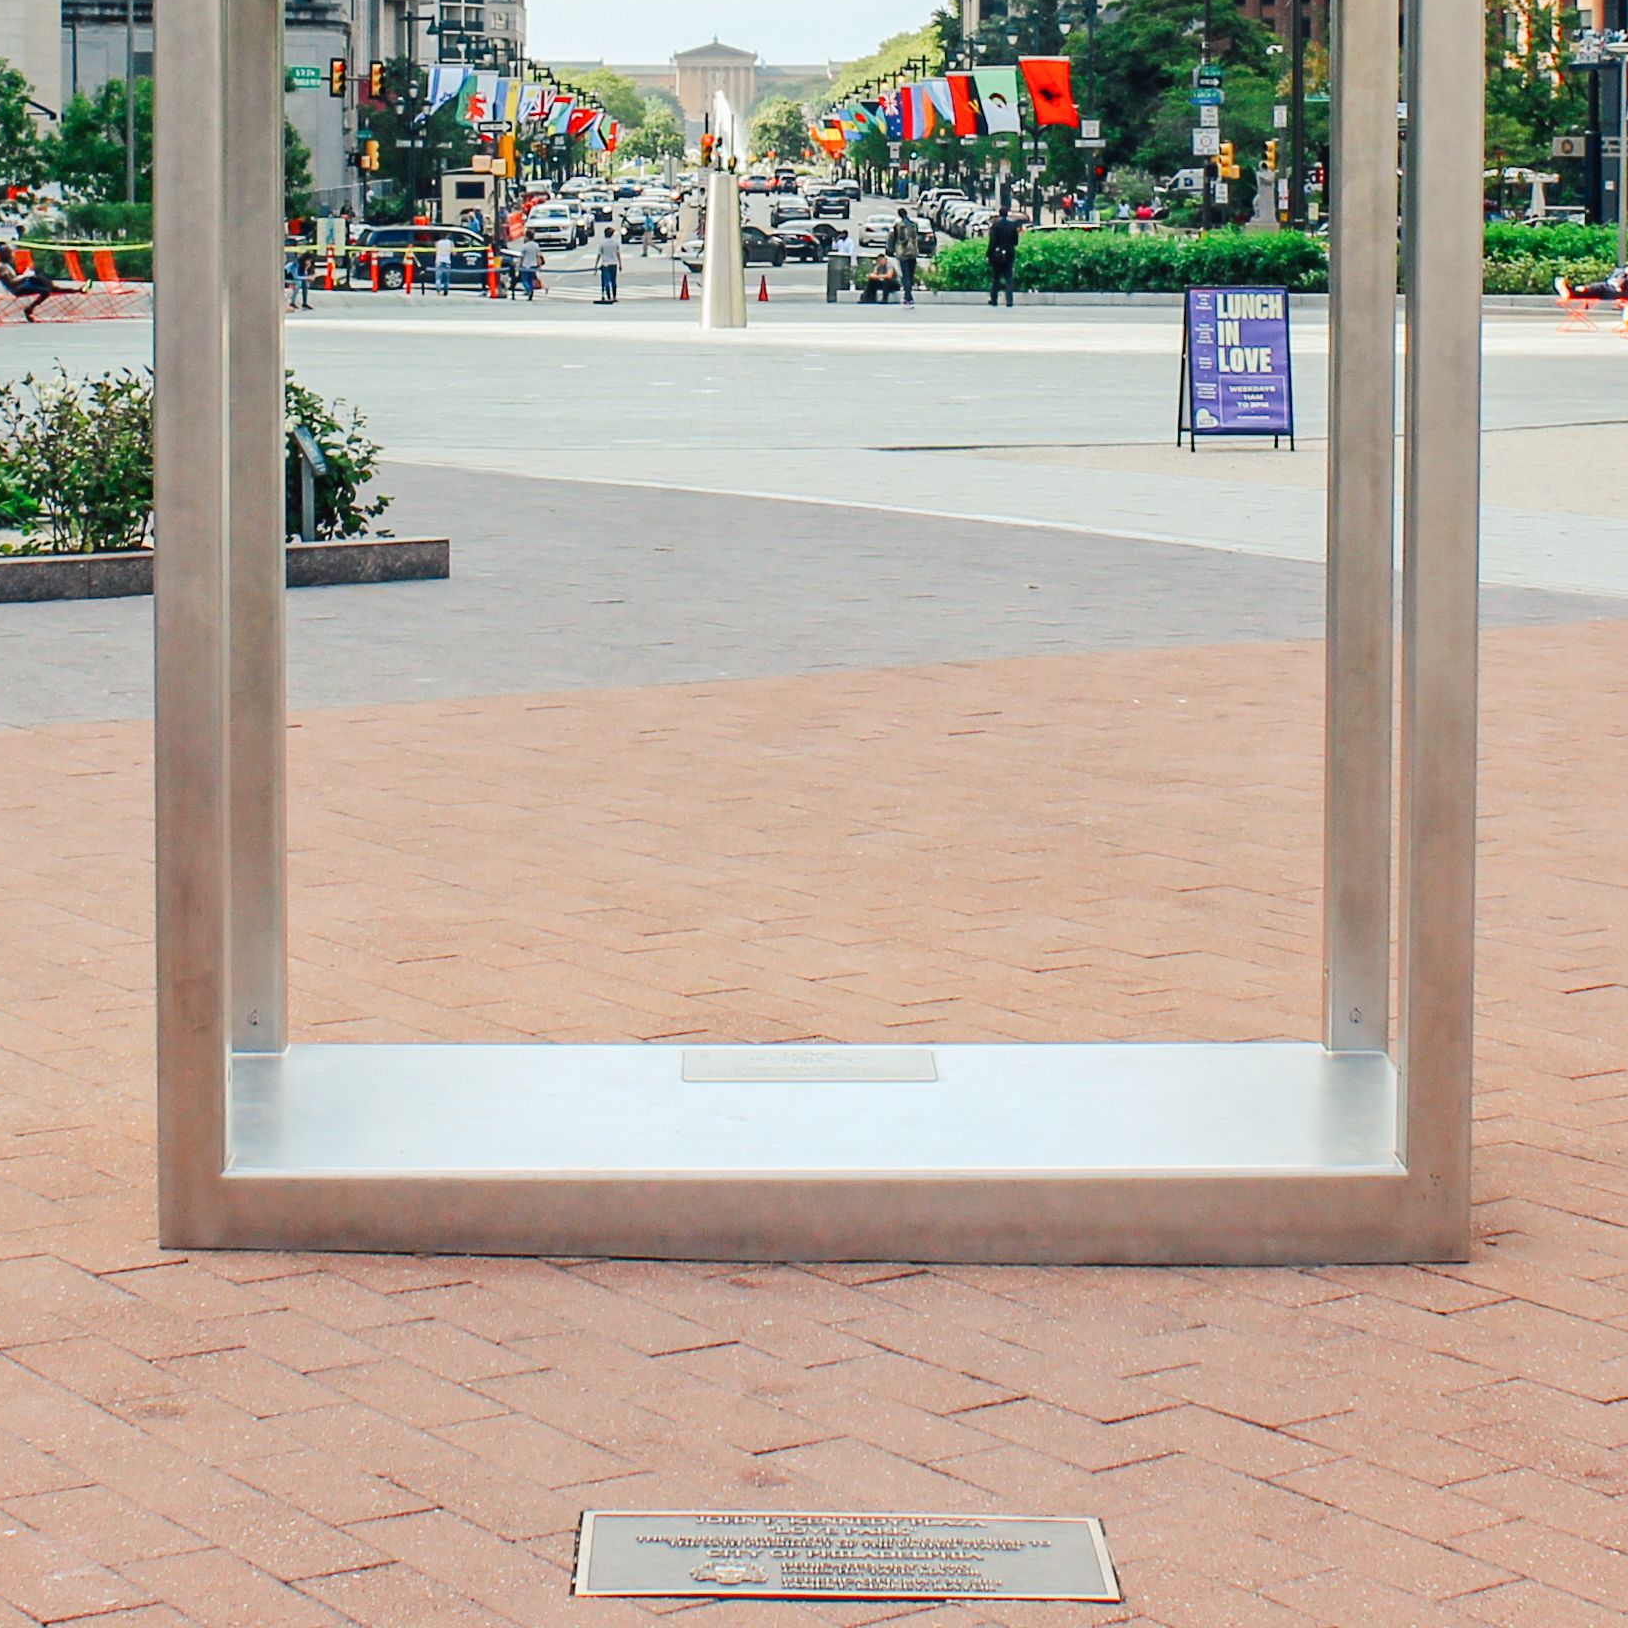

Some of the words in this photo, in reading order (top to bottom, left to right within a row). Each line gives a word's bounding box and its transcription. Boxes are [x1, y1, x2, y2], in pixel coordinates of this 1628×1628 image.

[1216, 293, 1284, 320] LUNCH
[1217, 320, 1240, 346] IN
[1217, 346, 1273, 373] LOVE
[1228, 385, 1276, 393] WEEKDAYS
[695, 1516, 758, 1525] JOHN
[788, 1516, 904, 1527] KENNEDY
[909, 1518, 988, 1528] PLAZA
[705, 1548, 764, 1559] CITY
[769, 1549, 801, 1559] OF
[806, 1549, 985, 1561] PHILADELPHIA
